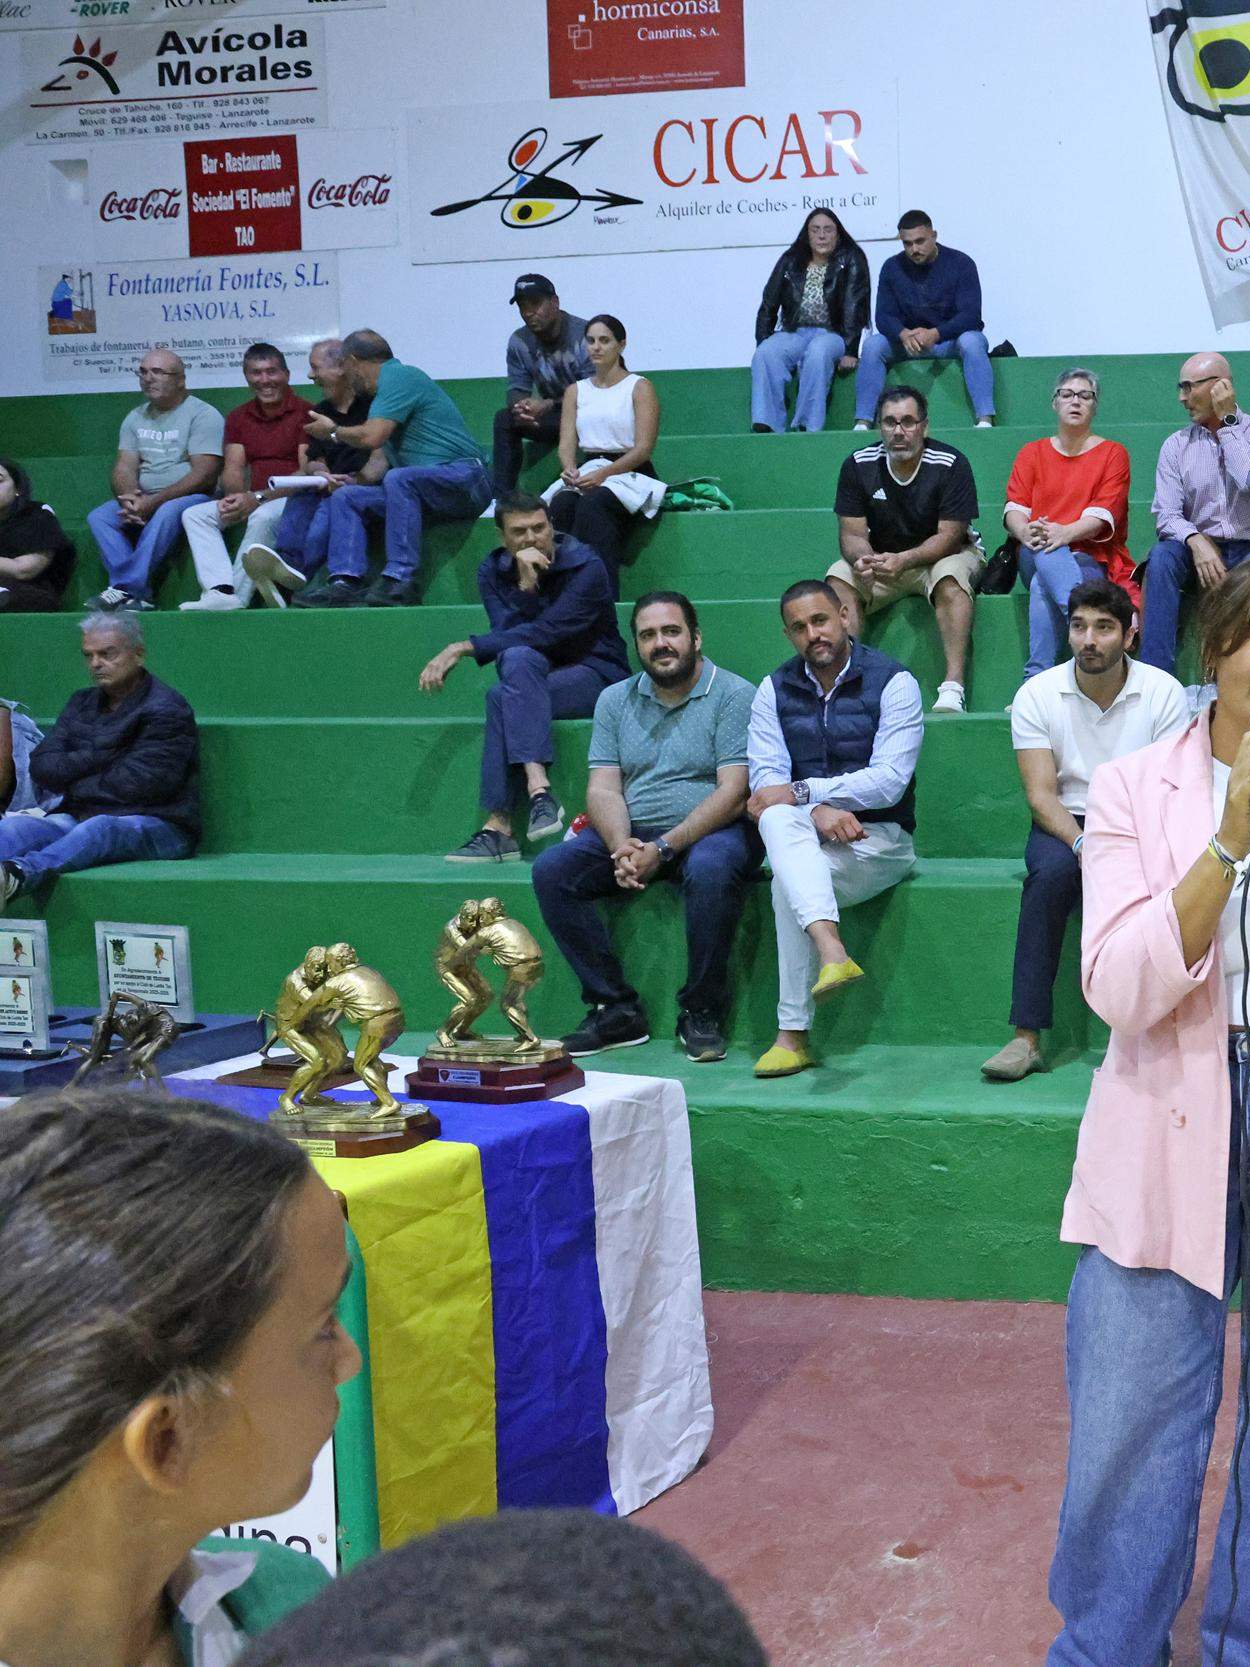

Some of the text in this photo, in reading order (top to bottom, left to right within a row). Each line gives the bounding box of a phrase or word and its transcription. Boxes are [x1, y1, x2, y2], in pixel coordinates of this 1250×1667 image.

[593, 0, 721, 21] hormiconsa
[156, 24, 308, 56] Avícola
[637, 26, 720, 40] Canarias, S.A.
[158, 56, 313, 87] Morales
[653, 110, 869, 187] CICAR
[202, 150, 282, 175] Bar Restaurante
[192, 191, 234, 213] Sociedad
[308, 174, 392, 209] Coca-Cola
[100, 188, 183, 223] Coca-Cola
[655, 193, 878, 220] Alquiler de Coches Rent a Car
[235, 227, 255, 246] TAO
[107, 263, 329, 296] Fontanería Fontes, S.L.
[162, 300, 276, 322] YASNOVA, S.L.
[48, 343, 88, 354] Trabajos
[91, 341, 102, 351] de
[207, 337, 236, 347] contra
